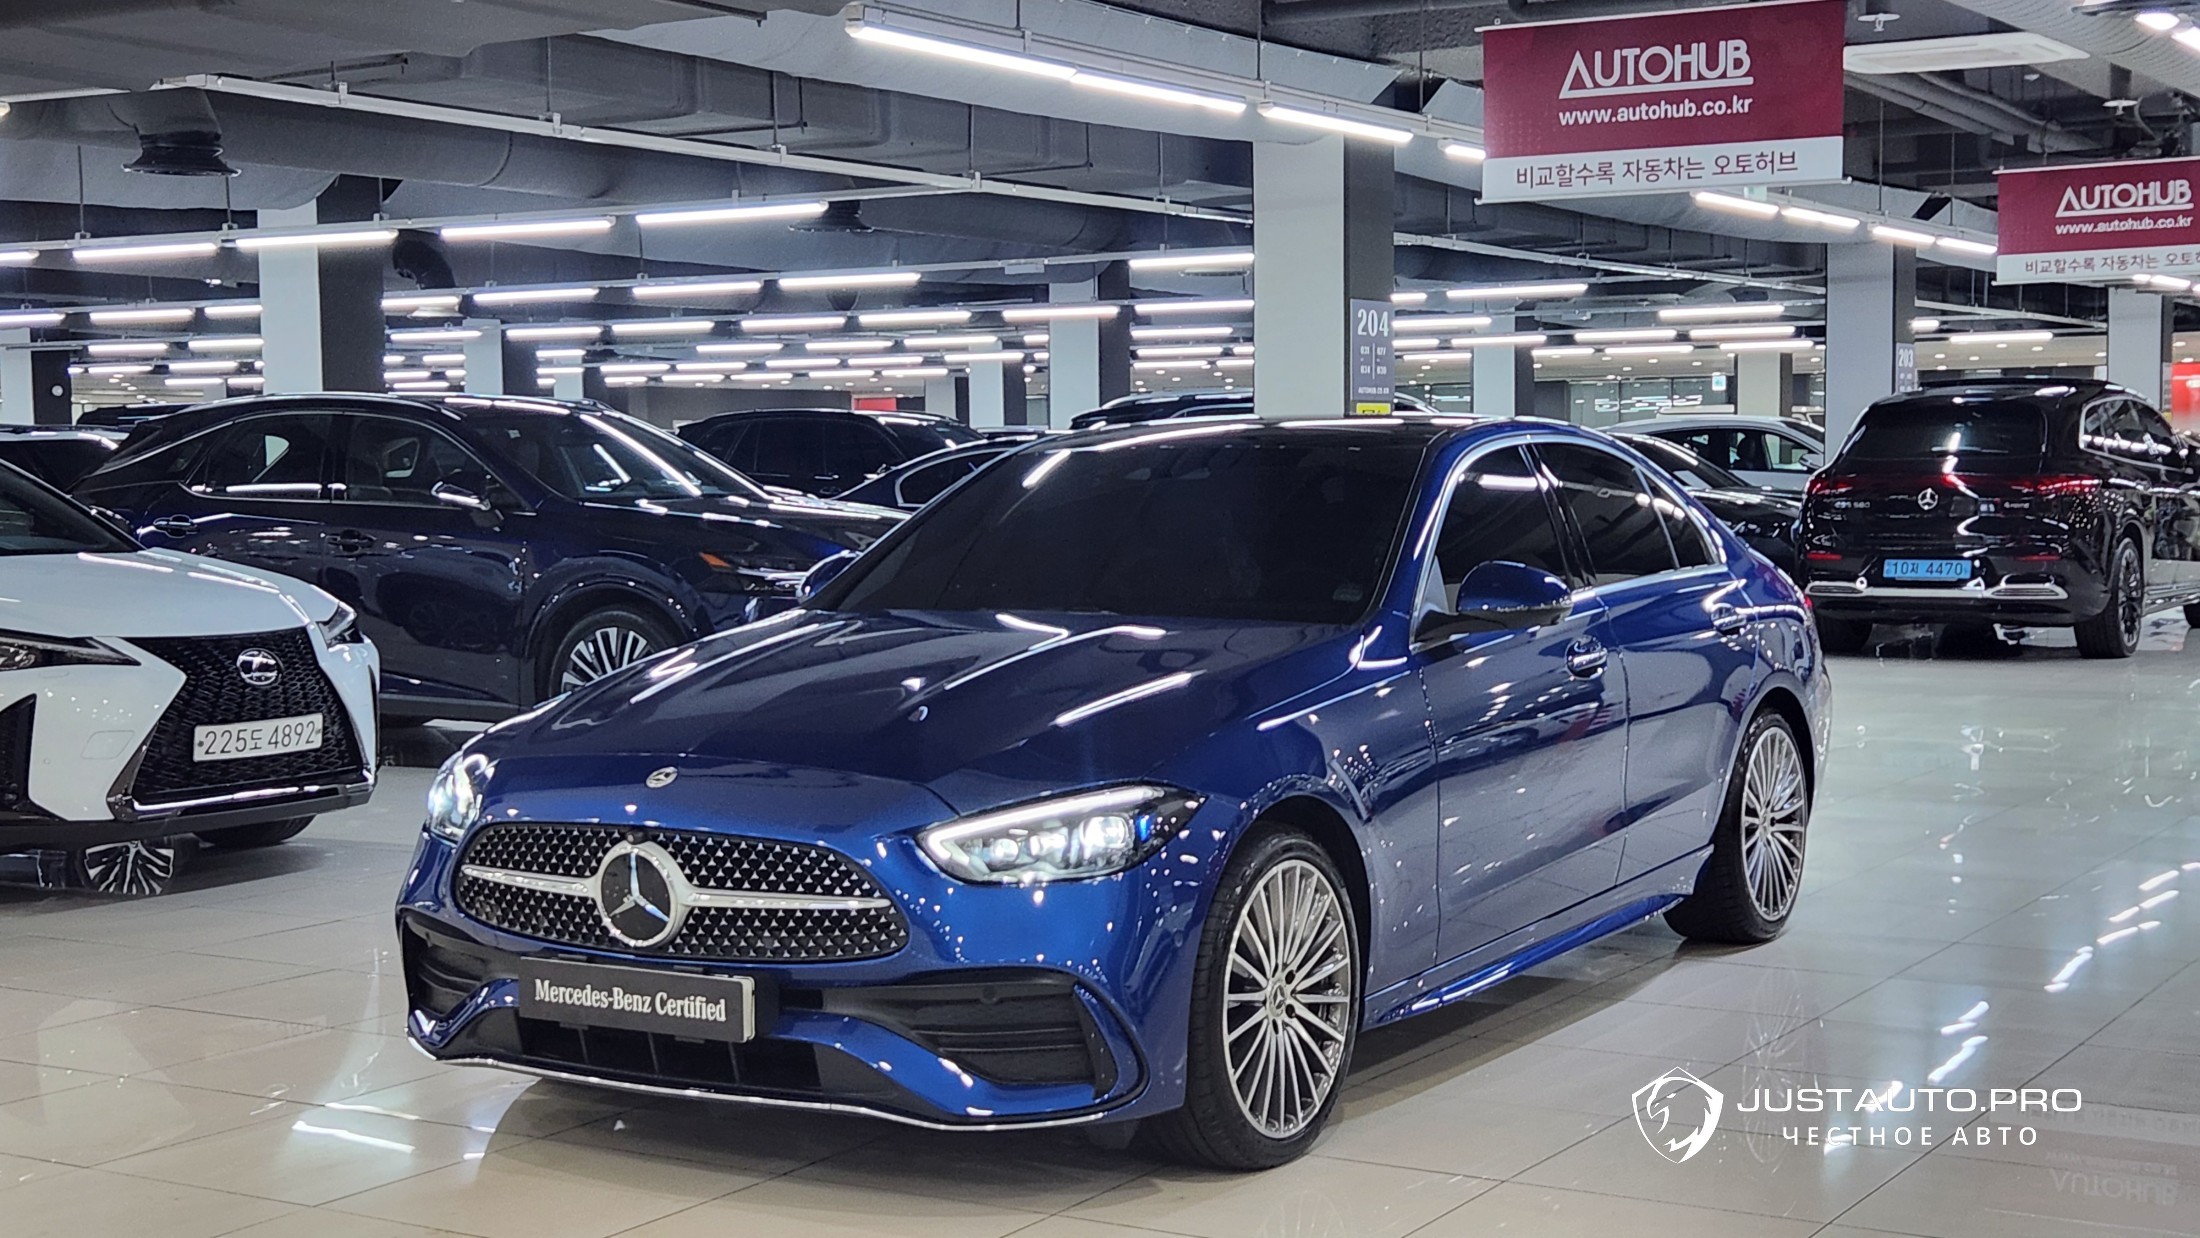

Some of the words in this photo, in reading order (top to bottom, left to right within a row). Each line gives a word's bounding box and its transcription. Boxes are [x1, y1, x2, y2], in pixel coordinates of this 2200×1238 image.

[1558, 39, 1754, 99] AUTOHUB
[1559, 95, 1753, 126] www.autohub.co.kr
[1516, 157, 1616, 189] 비교할수록
[1622, 155, 1705, 184] 자동차는
[1712, 150, 1799, 176] 오토허브
[2054, 179, 2194, 218] AUTOHUB
[2055, 215, 2193, 235] www.autohub.co.kr
[2025, 257, 2095, 275] 비교할수록
[2101, 253, 2160, 271] 자동차는
[1357, 308, 1389, 337] 204
[1898, 348, 1914, 368] 203
[1925, 561, 1964, 576] 4470
[203, 728, 263, 756] 225도
[267, 720, 316, 749] 4892
[534, 978, 652, 1011] Mercedes-Benz
[654, 991, 727, 1022] Certified
